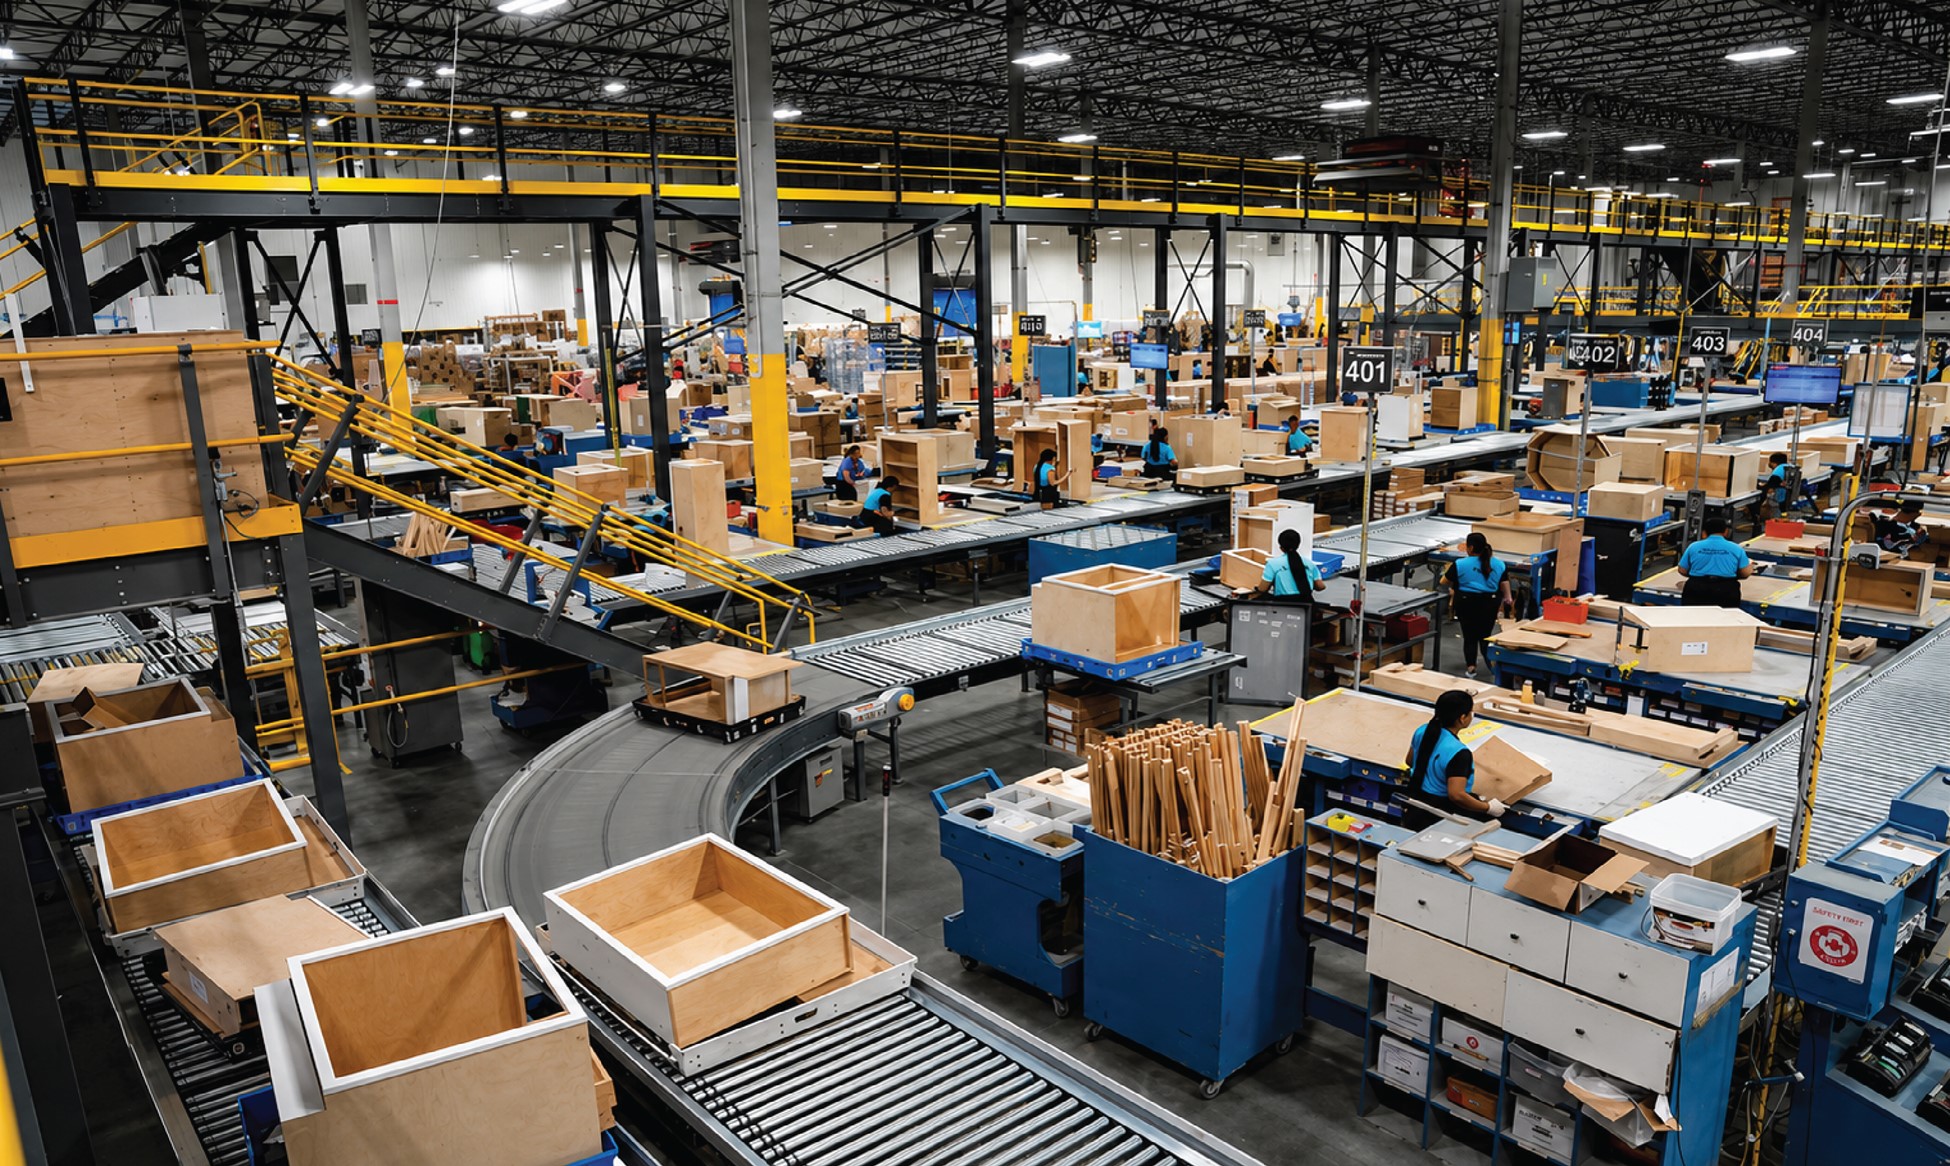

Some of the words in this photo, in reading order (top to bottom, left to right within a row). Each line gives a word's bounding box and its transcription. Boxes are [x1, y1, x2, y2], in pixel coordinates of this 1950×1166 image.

[1793, 327, 1823, 342] 404
[1692, 336, 1724, 352] 403
[1581, 345, 1615, 363] 402
[1345, 360, 1385, 383] 401
